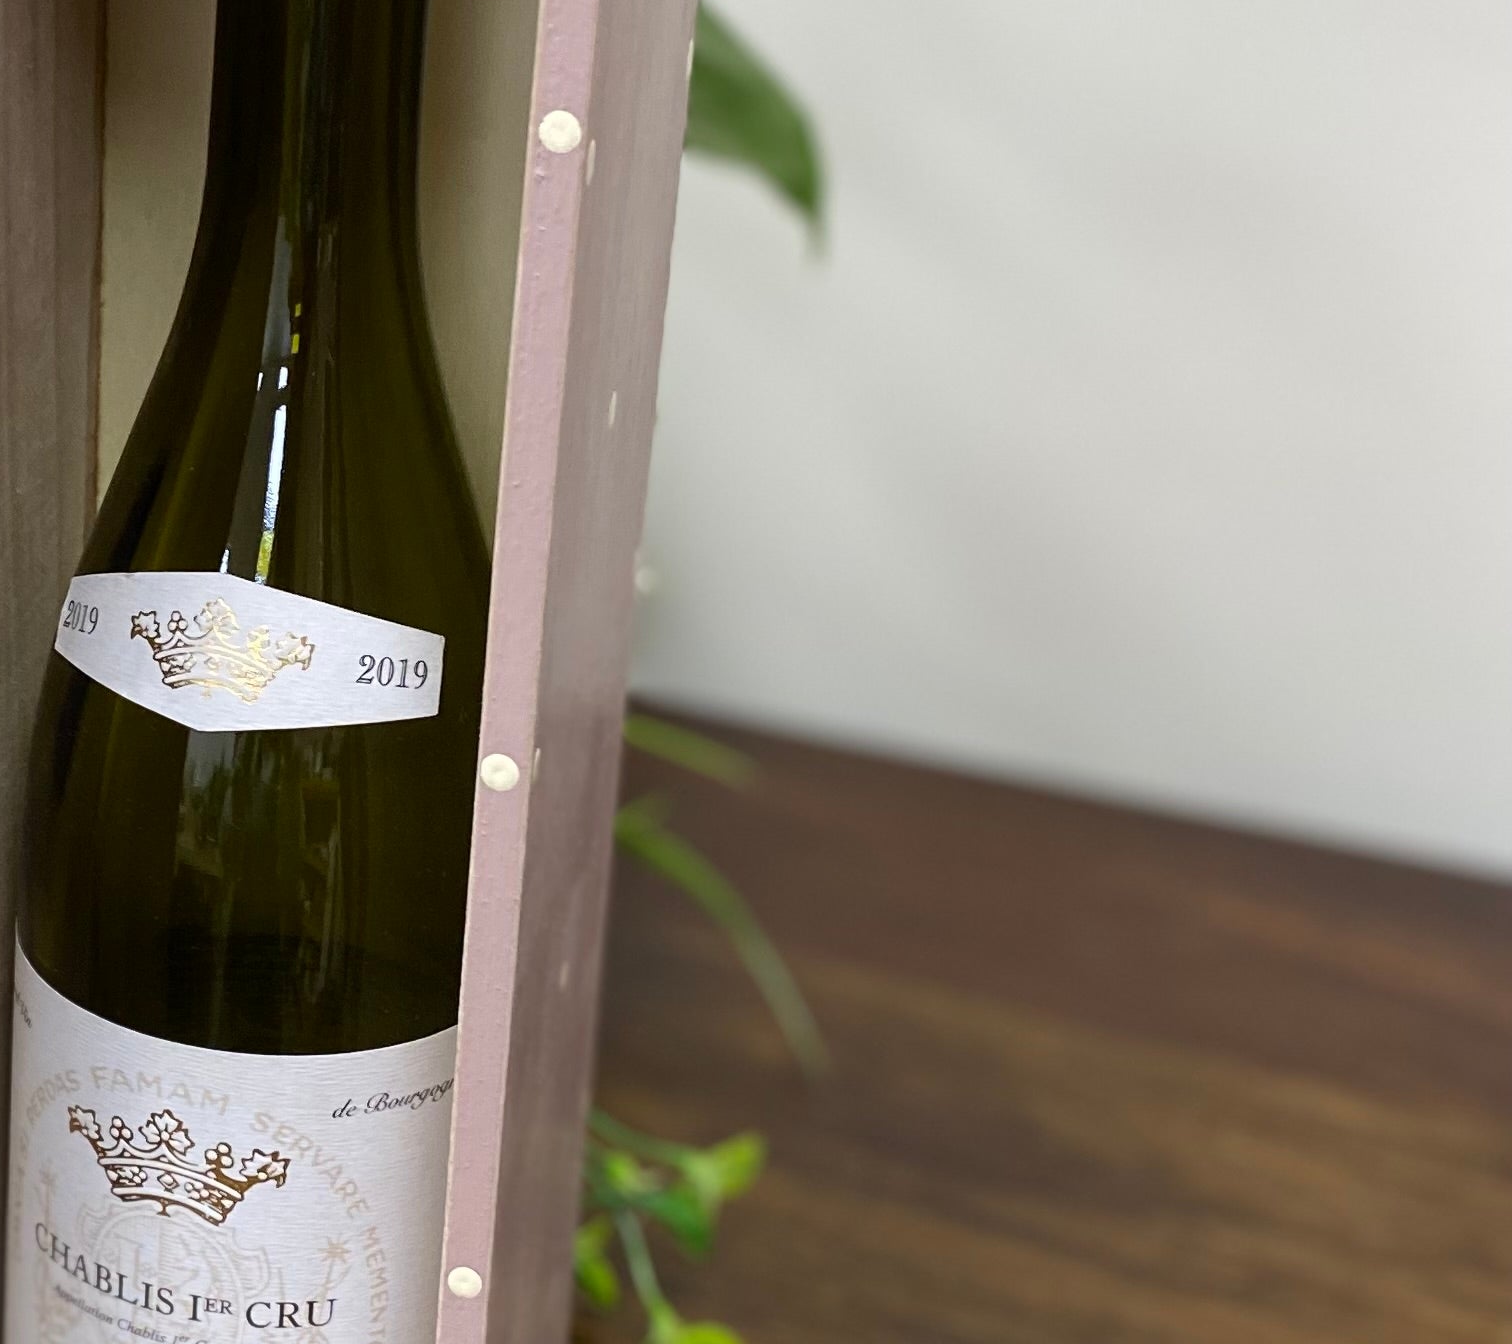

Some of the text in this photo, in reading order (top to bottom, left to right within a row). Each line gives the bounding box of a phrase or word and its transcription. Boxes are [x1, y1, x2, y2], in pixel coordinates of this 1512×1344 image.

[62, 599, 100, 636] 2019
[355, 654, 429, 691] 2019
[331, 1077, 455, 1119] de Bourgog
[90, 1065, 231, 1116] FAMAM
[249, 1110, 370, 1220] SERVARE
[34, 1221, 175, 1316] CHABLIS
[245, 1298, 339, 1329] CRU
[116, 1317, 167, 1344] Chablis
